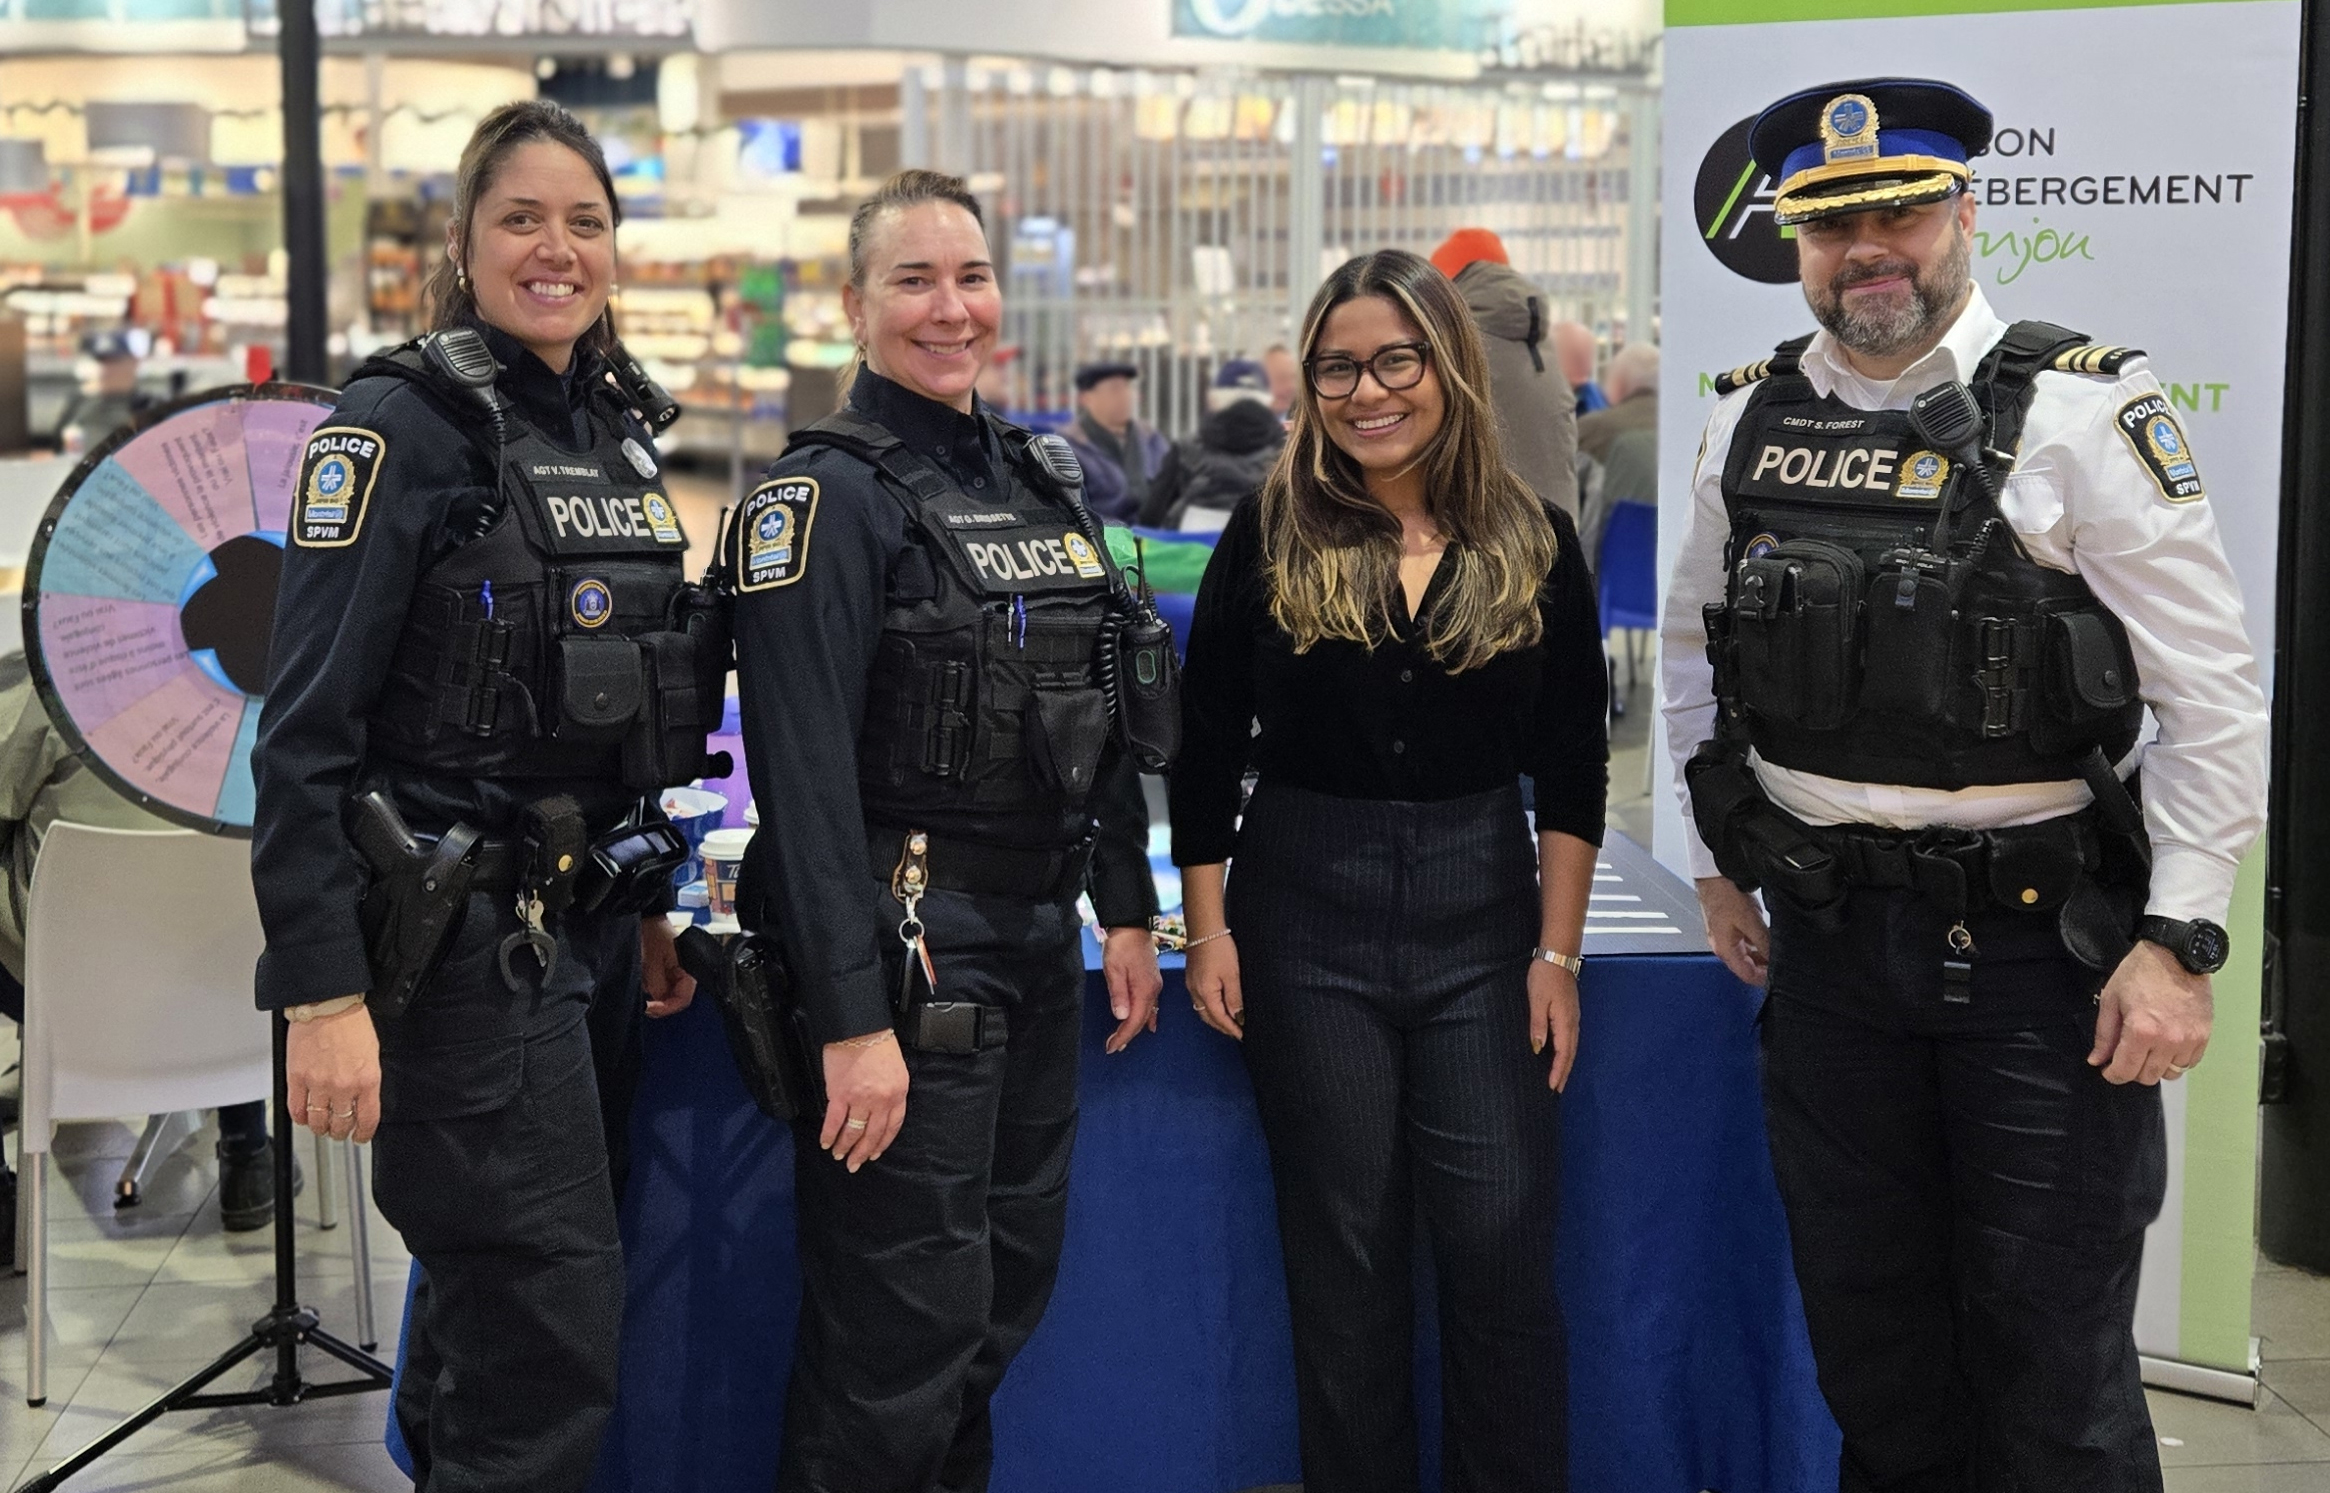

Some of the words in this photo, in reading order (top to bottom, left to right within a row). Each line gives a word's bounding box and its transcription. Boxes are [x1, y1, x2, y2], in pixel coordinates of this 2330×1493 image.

[1783, 416, 1814, 428] CMDT
[1815, 421, 1824, 430] S.
[1825, 419, 1865, 430] FOREST
[308, 437, 376, 460] POLICE
[1752, 445, 1898, 490] POLICE
[747, 486, 810, 516] POLICE
[547, 496, 651, 537] POLICE
[306, 526, 339, 538] SPVM
[966, 539, 1074, 580] POLICE
[753, 566, 786, 583] SPVM
